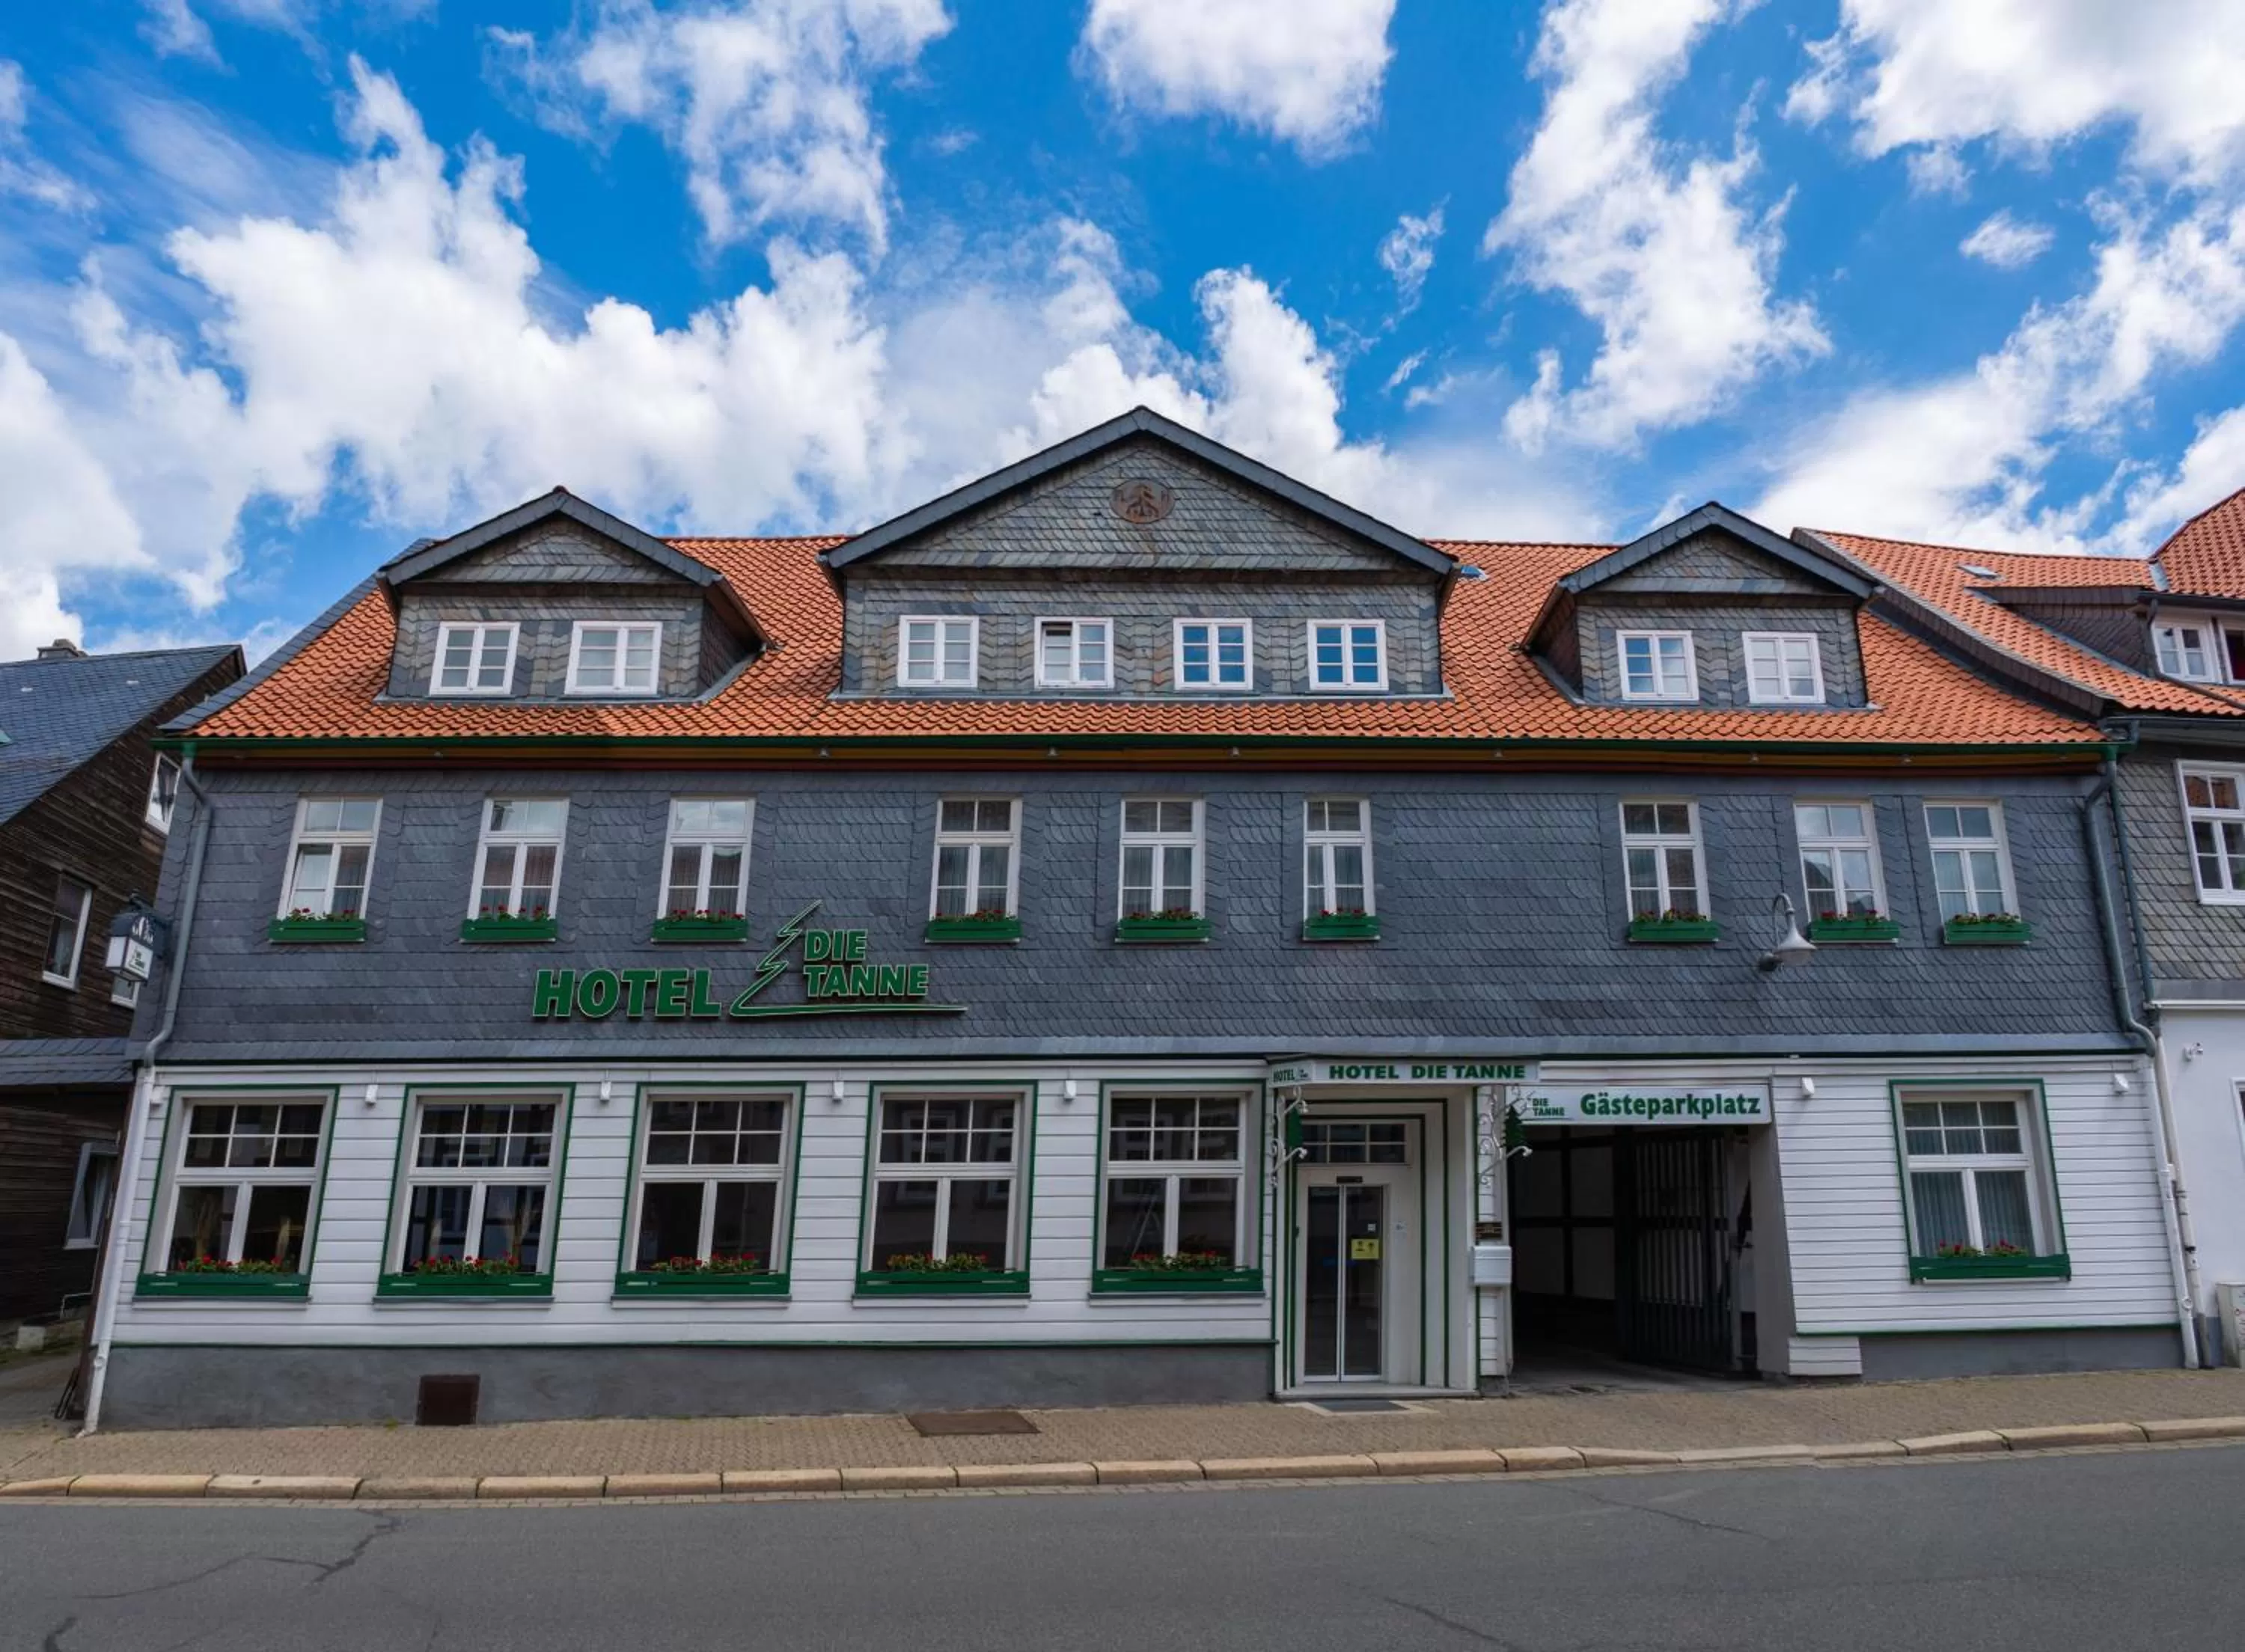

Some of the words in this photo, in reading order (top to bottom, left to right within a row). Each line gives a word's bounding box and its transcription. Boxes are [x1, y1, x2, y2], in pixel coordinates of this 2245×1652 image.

[804, 929, 868, 961] DIE
[532, 969, 722, 1018] HOTEL
[803, 964, 929, 997] TANNE
[1329, 1065, 1399, 1079] HOTEL
[1411, 1065, 1452, 1079] DIE
[1453, 1065, 1525, 1079] TANNE
[1532, 1098, 1550, 1107] DIE
[1532, 1107, 1566, 1117] TANNE
[1580, 1092, 1761, 1119] Gästeparkplatz
